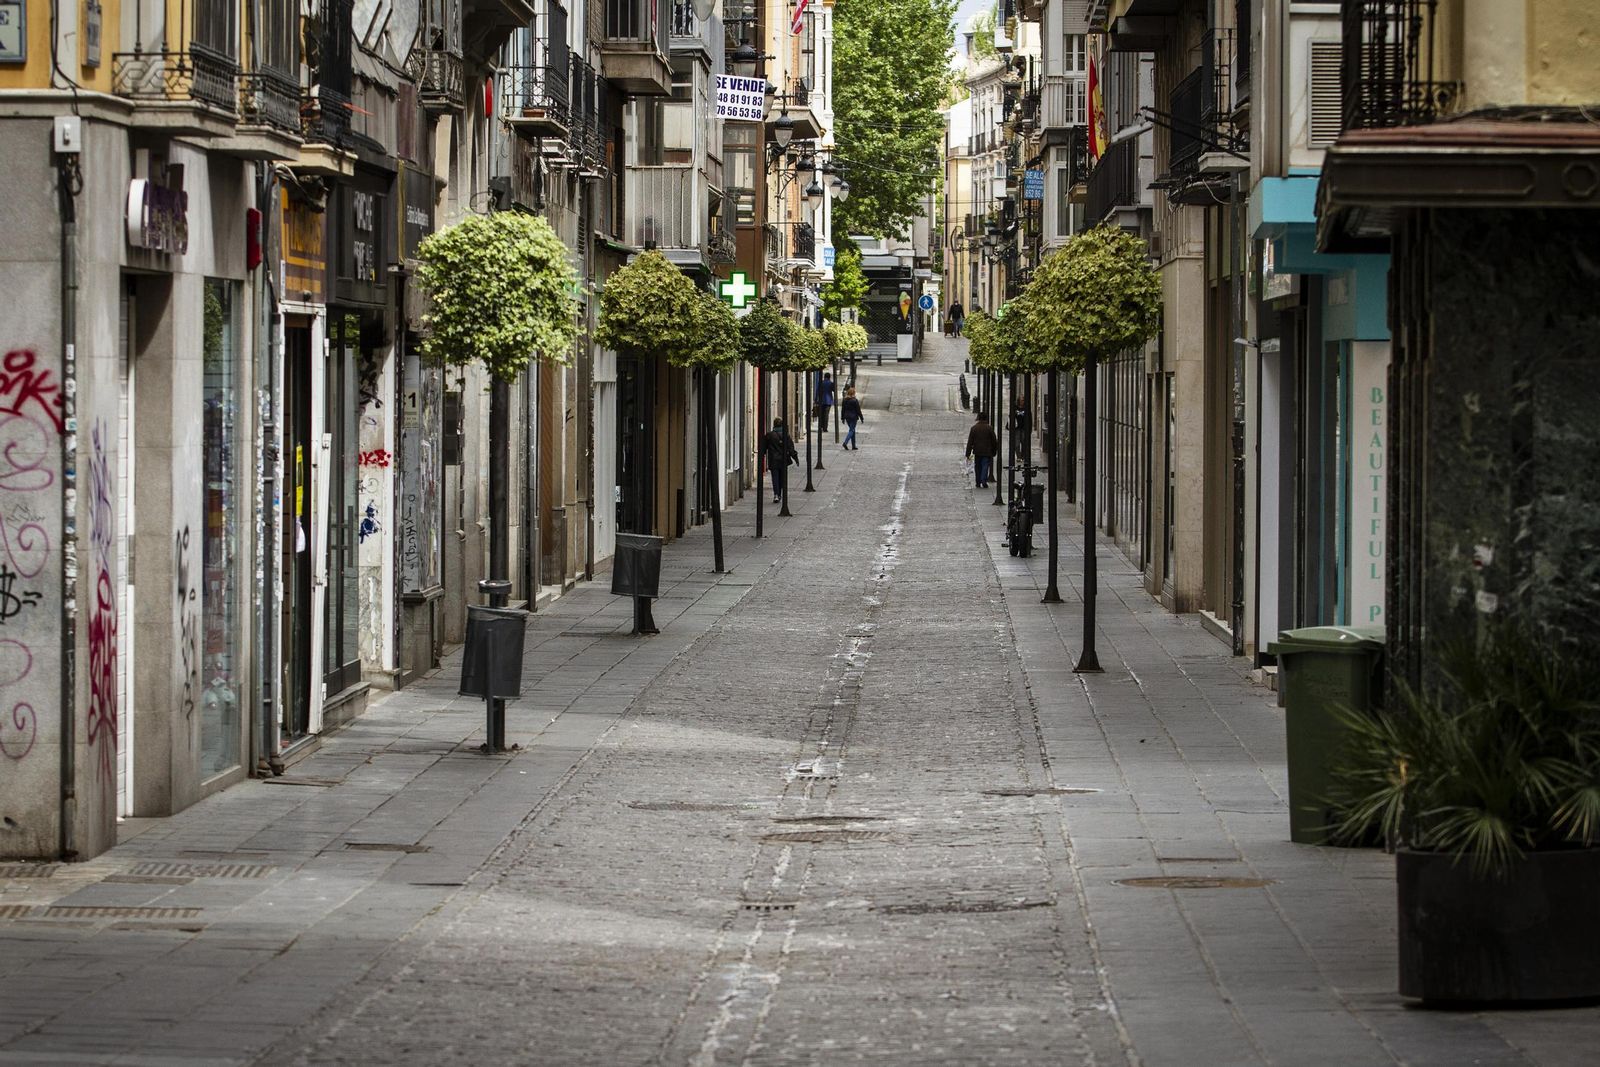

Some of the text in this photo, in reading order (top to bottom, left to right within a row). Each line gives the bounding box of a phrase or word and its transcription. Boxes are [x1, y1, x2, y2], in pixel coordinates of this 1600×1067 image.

[716, 76, 764, 93] SE VENDE
[716, 92, 763, 107] 48 81 91 83
[727, 106, 738, 116] 56
[739, 108, 750, 118] 53
[751, 108, 762, 119] 58
[1026, 171, 1033, 179] SE
[1369, 387, 1383, 579] BEAUTIFUL
